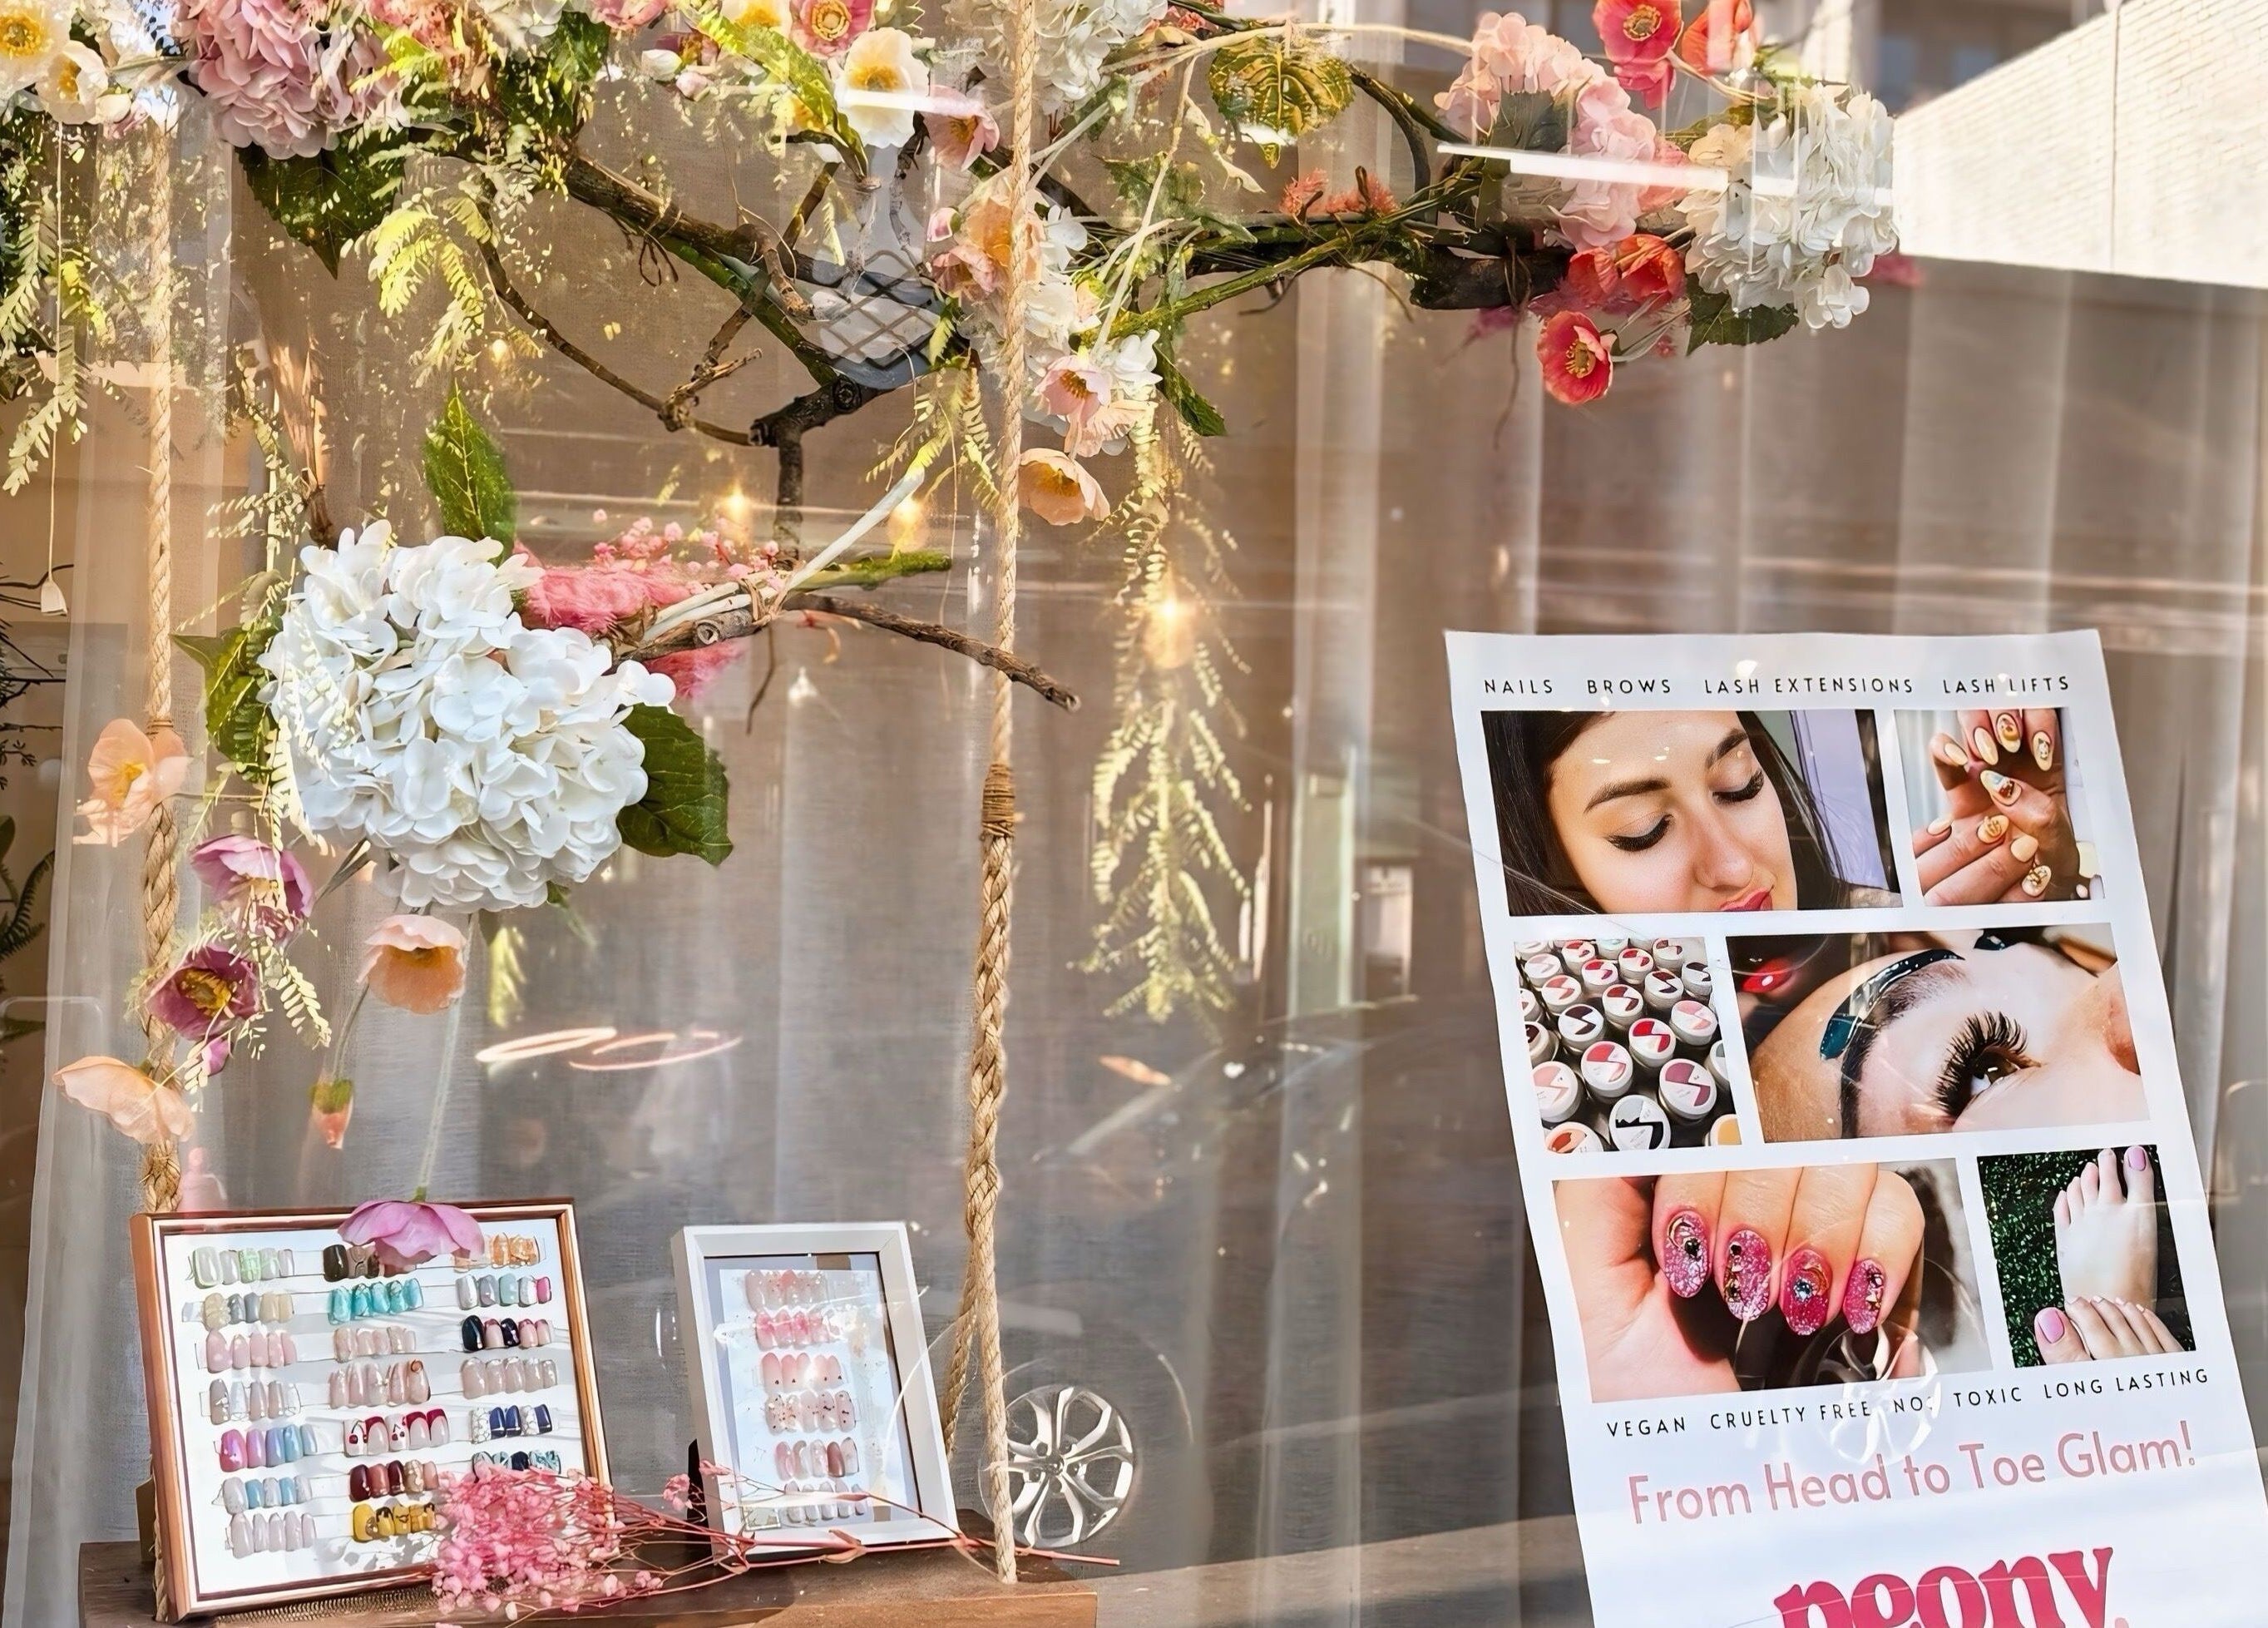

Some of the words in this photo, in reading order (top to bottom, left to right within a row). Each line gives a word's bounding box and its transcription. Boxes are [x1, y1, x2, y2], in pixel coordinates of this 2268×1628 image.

[1484, 678, 1554, 695] NAILS
[1586, 678, 1672, 695] BROWS
[1703, 678, 1760, 695] LASH
[1774, 676, 1913, 694] EXTENSIONS
[1942, 678, 1996, 695] LASH
[2009, 675, 2069, 693] LIFTS
[1605, 1416, 1687, 1438] VEGAN
[1709, 1406, 1806, 1431] CRUELTY
[1819, 1400, 1871, 1421] FREE
[1892, 1396, 1939, 1414] NO
[1952, 1386, 2023, 1408] TOXIC
[2043, 1378, 2103, 1400] LONG
[2115, 1368, 2209, 1393] LASTING
[1628, 1474, 1752, 1525] From
[1762, 1452, 1892, 1512] Head
[1903, 1454, 1951, 1497] to
[1958, 1442, 2047, 1490] Toe
[2057, 1419, 2196, 1478] Glam!
